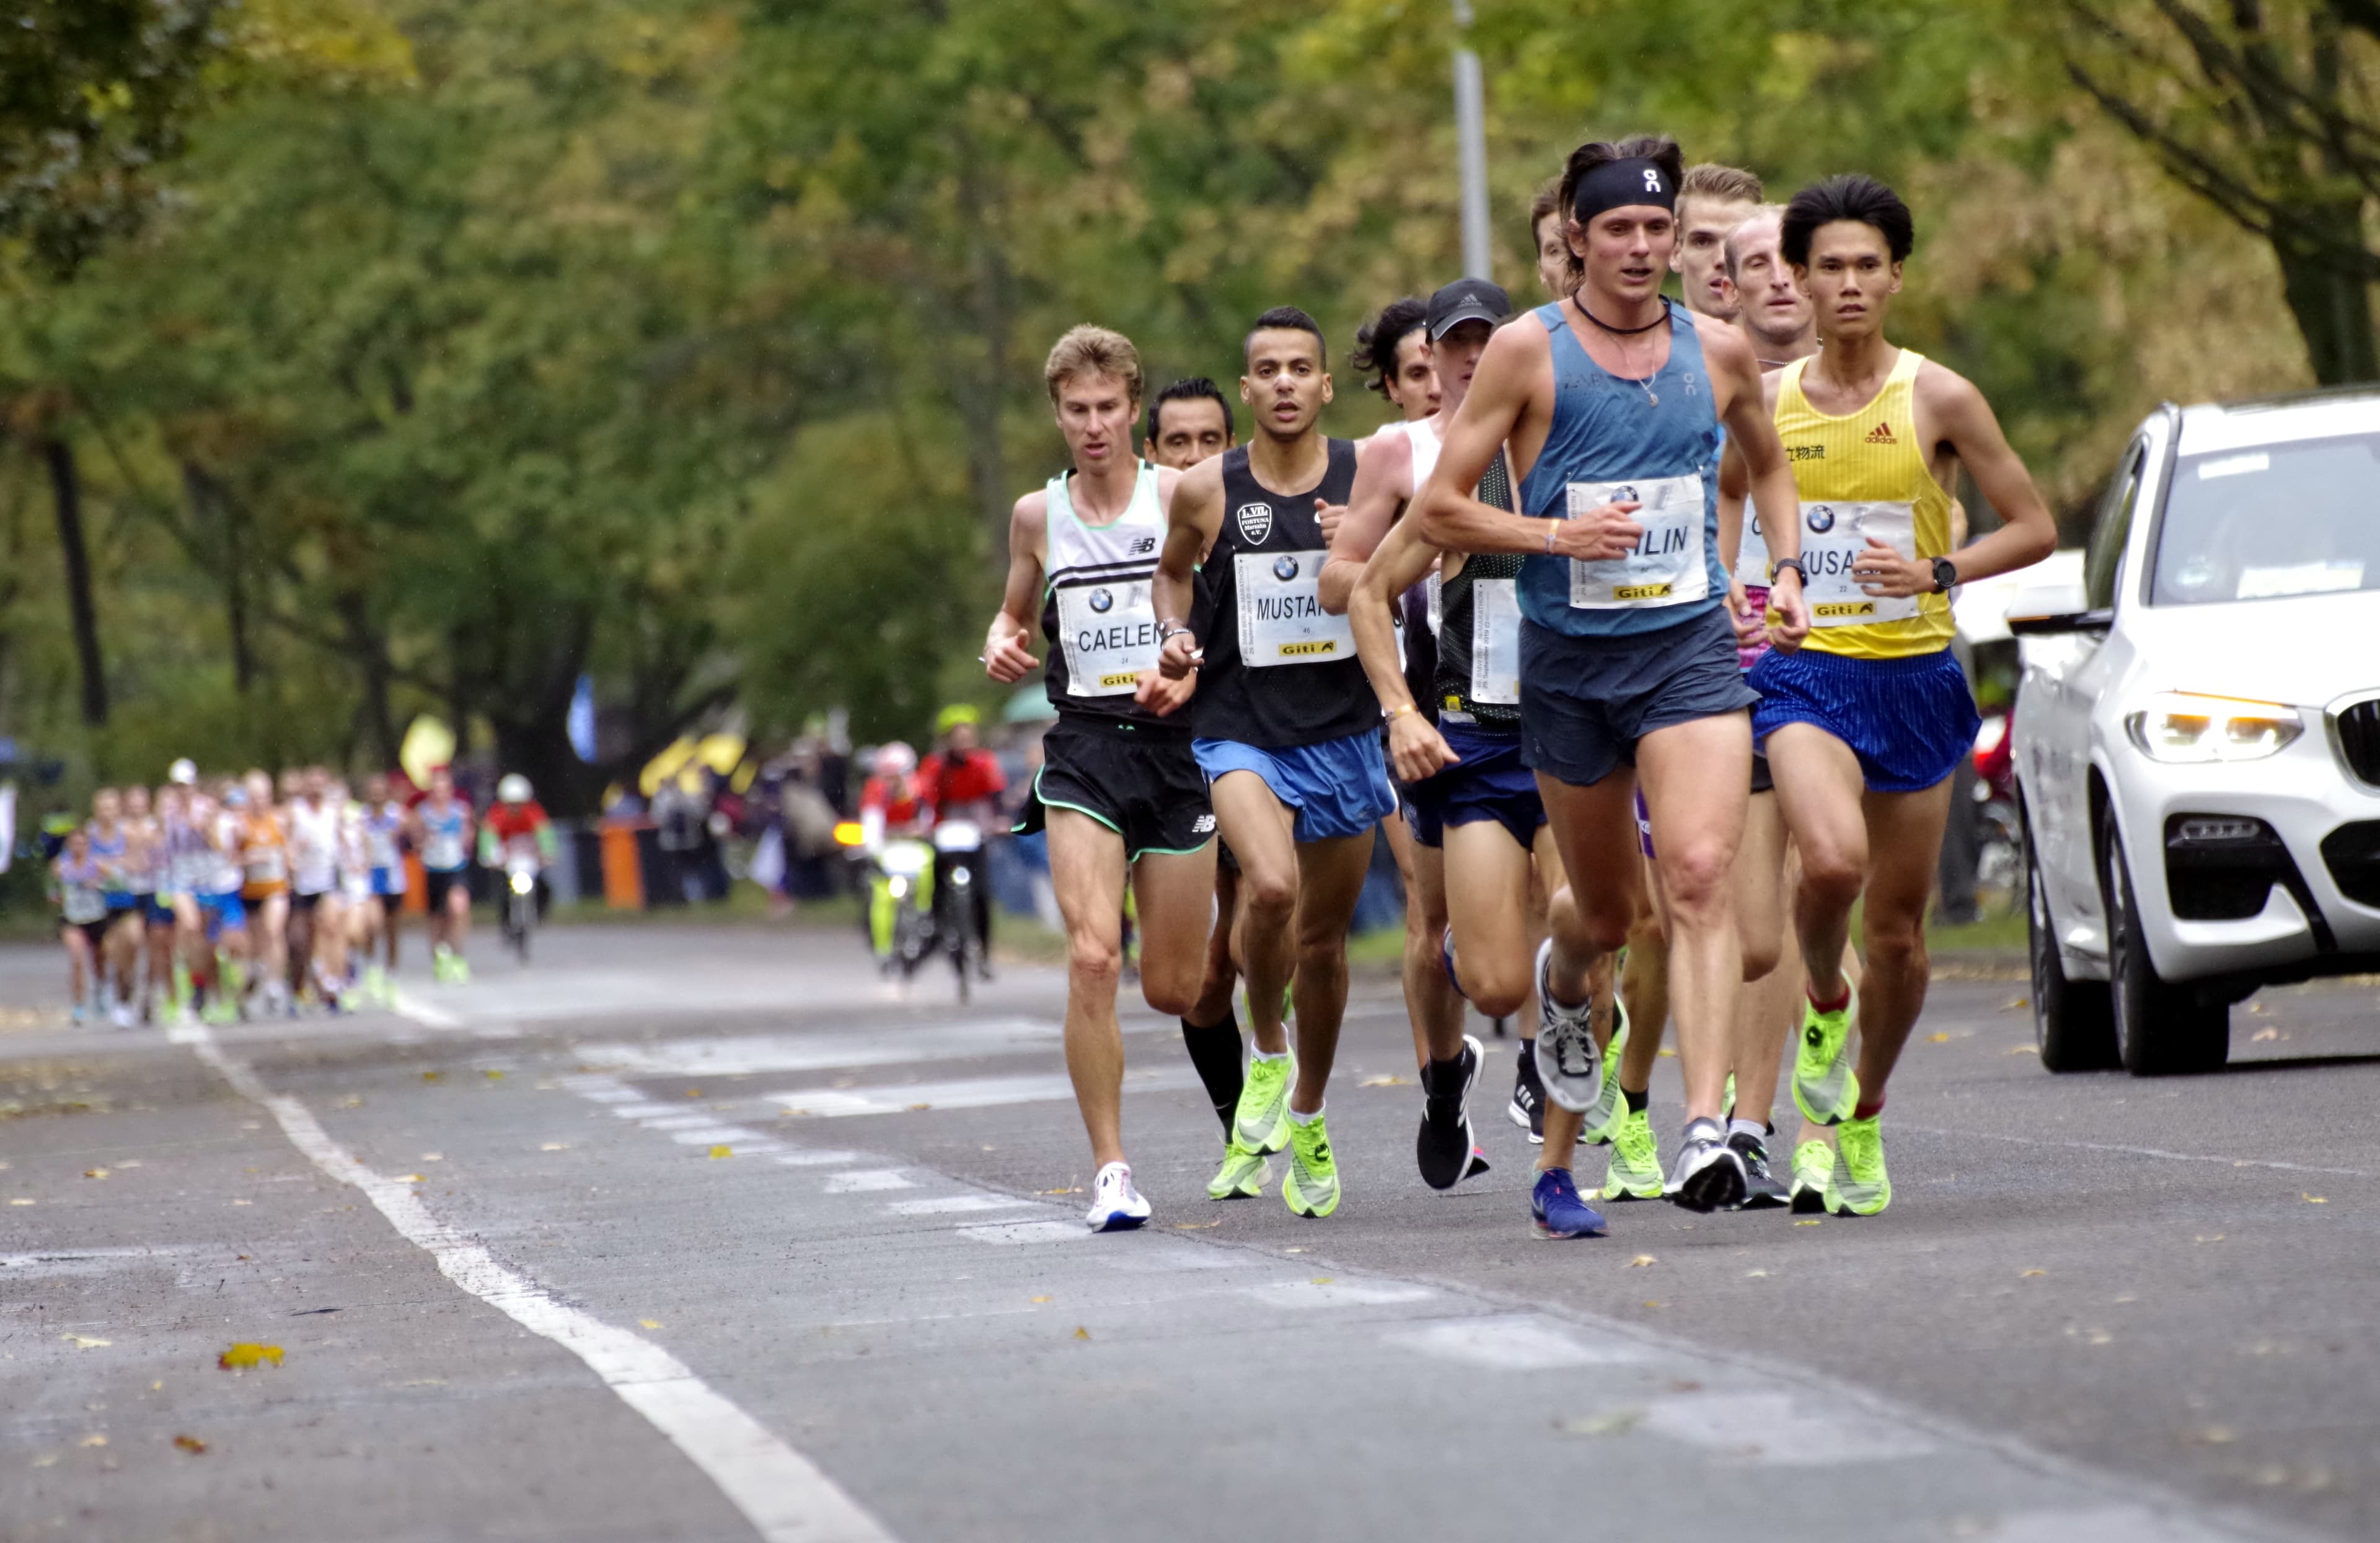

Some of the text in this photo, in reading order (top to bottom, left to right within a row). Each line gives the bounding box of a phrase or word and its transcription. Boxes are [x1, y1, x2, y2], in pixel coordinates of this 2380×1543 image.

[1865, 436, 1898, 444] adidas
[1241, 517, 1269, 526] FORTUNA
[1800, 550, 1854, 576] USA
[1618, 589, 1654, 599] Giti
[1257, 596, 1321, 620] MUSTA
[1817, 604, 1853, 616] Giti
[1282, 644, 1315, 654] Giti
[1103, 674, 1134, 685] Giti
